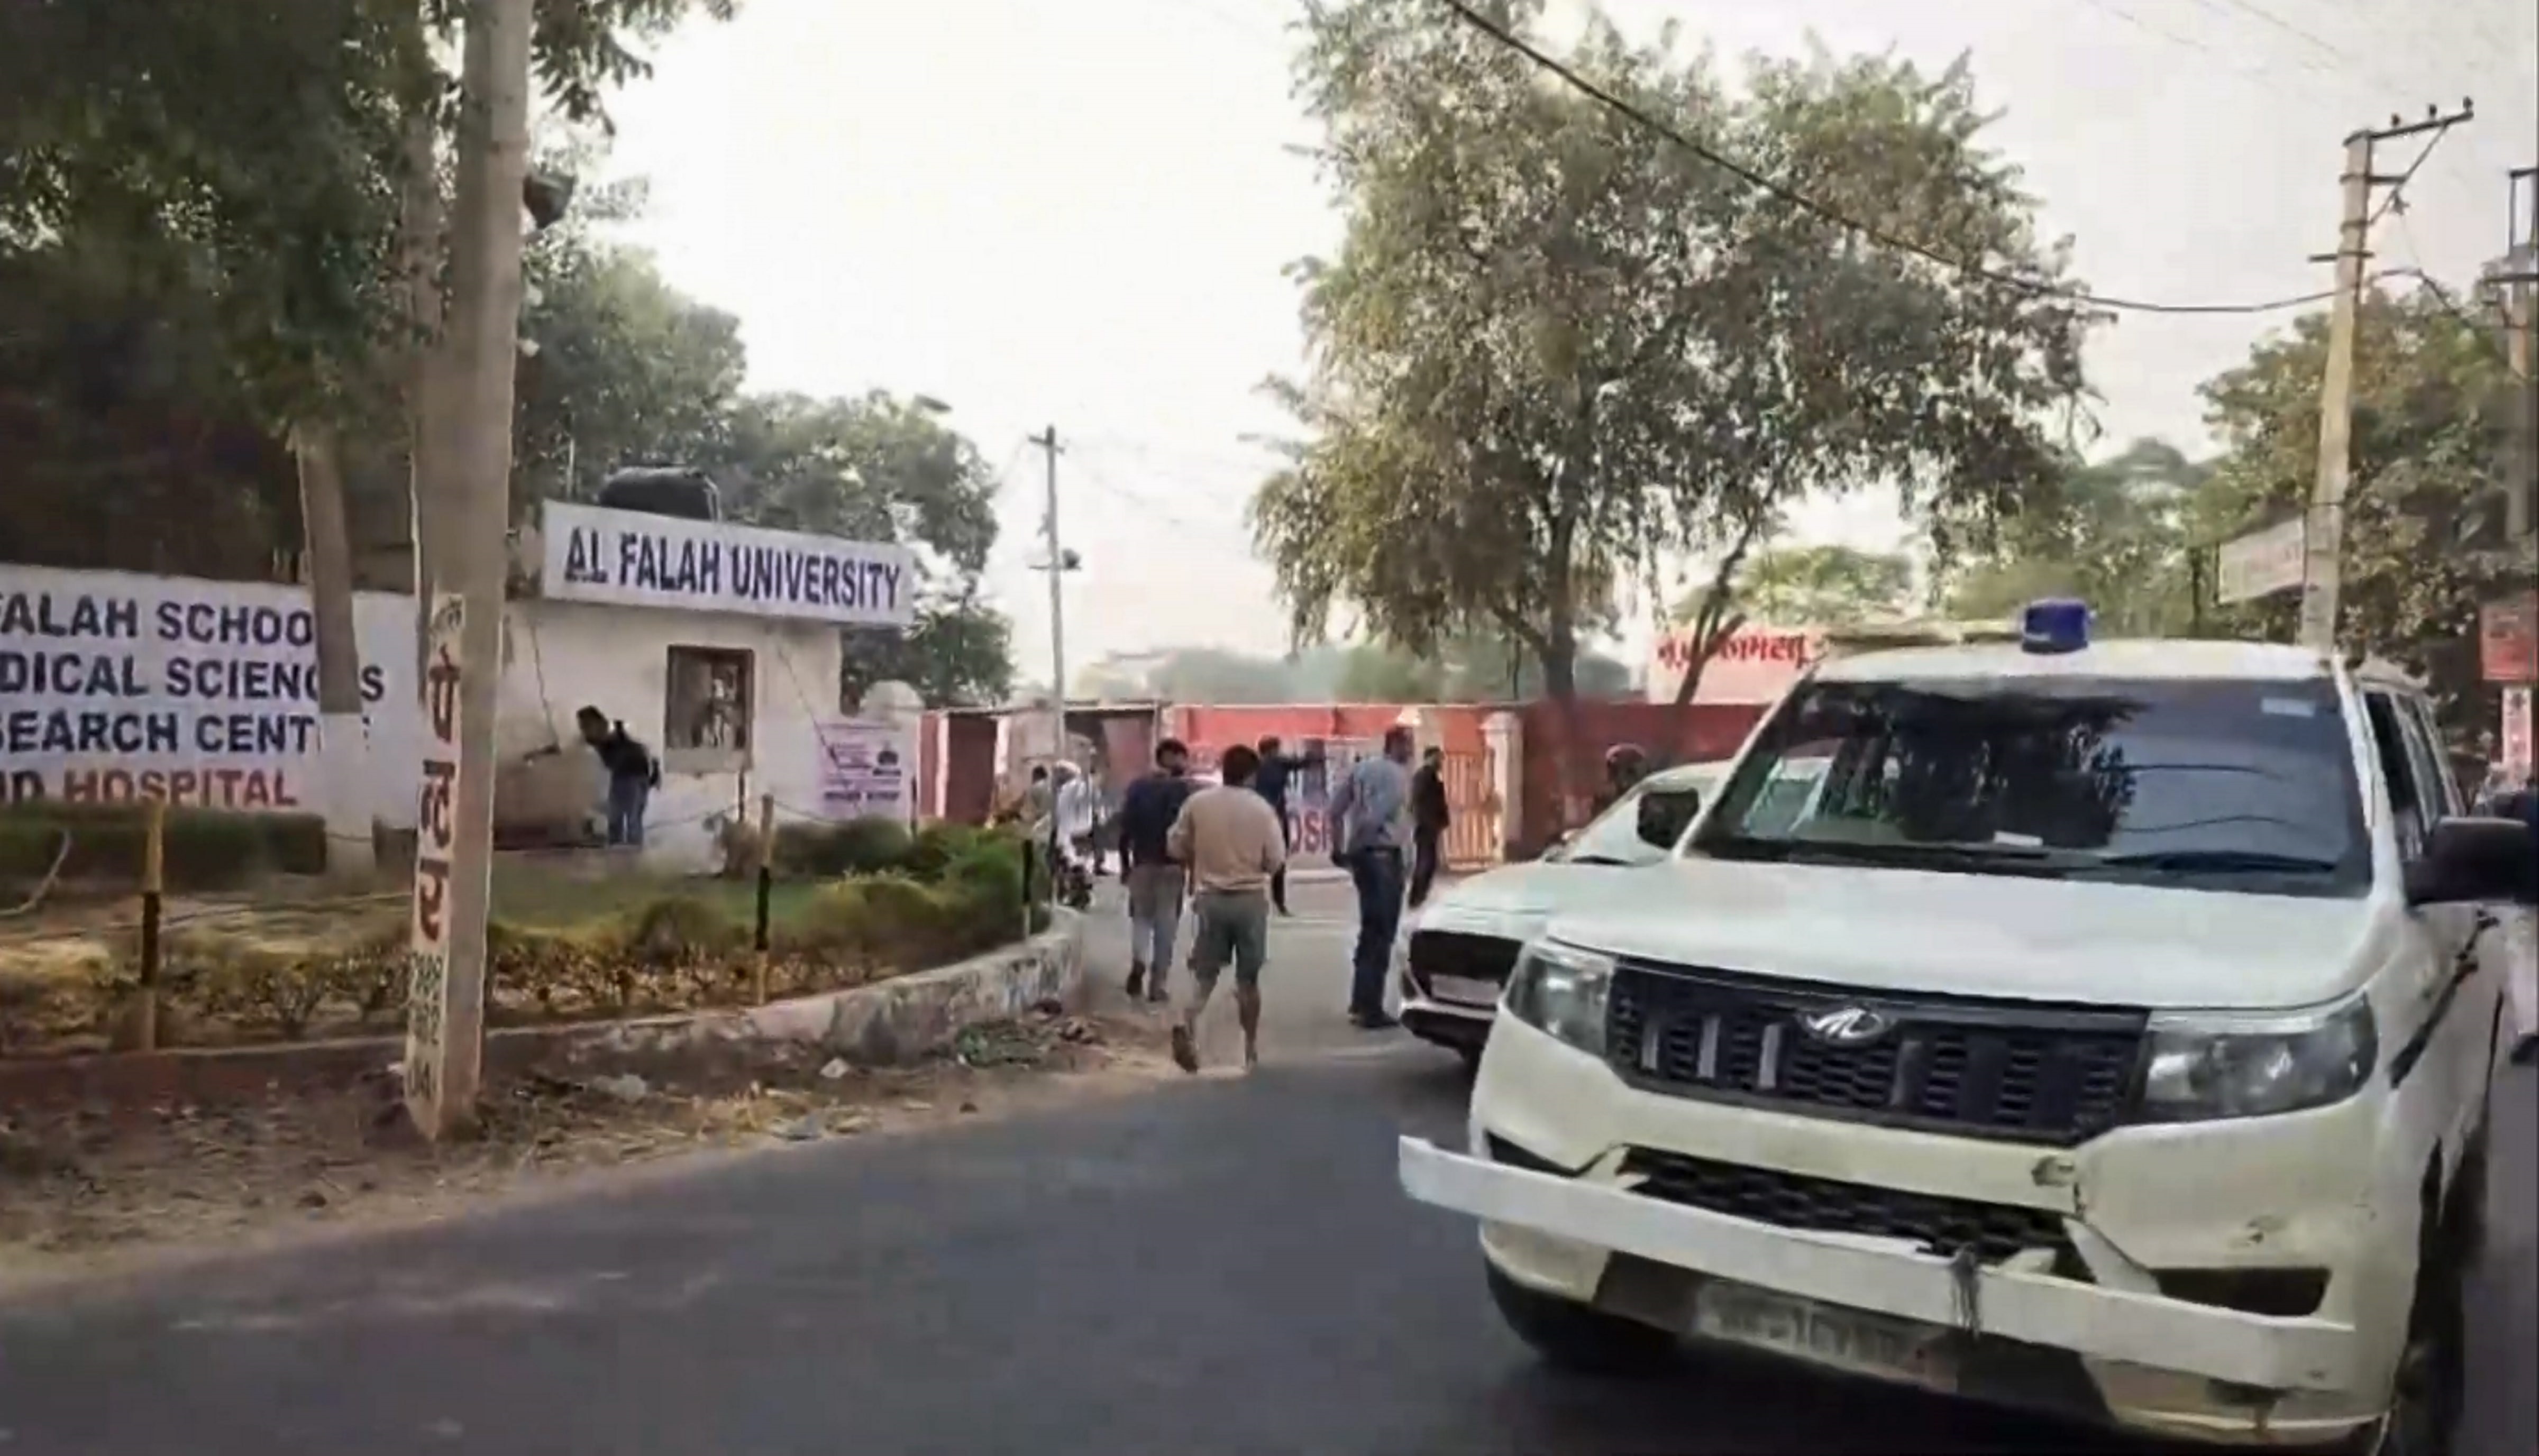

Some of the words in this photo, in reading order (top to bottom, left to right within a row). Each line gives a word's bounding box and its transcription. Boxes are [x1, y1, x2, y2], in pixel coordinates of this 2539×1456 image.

[564, 526, 607, 583] AL
[620, 533, 720, 594] FALAH
[730, 545, 900, 609] UNIVERSITY
[0, 591, 138, 638] ALAH
[157, 601, 313, 646] SCHOO
[166, 658, 384, 702] SCIENCS
[0, 709, 178, 753] EARCH
[64, 768, 297, 807] HOSPITAL
